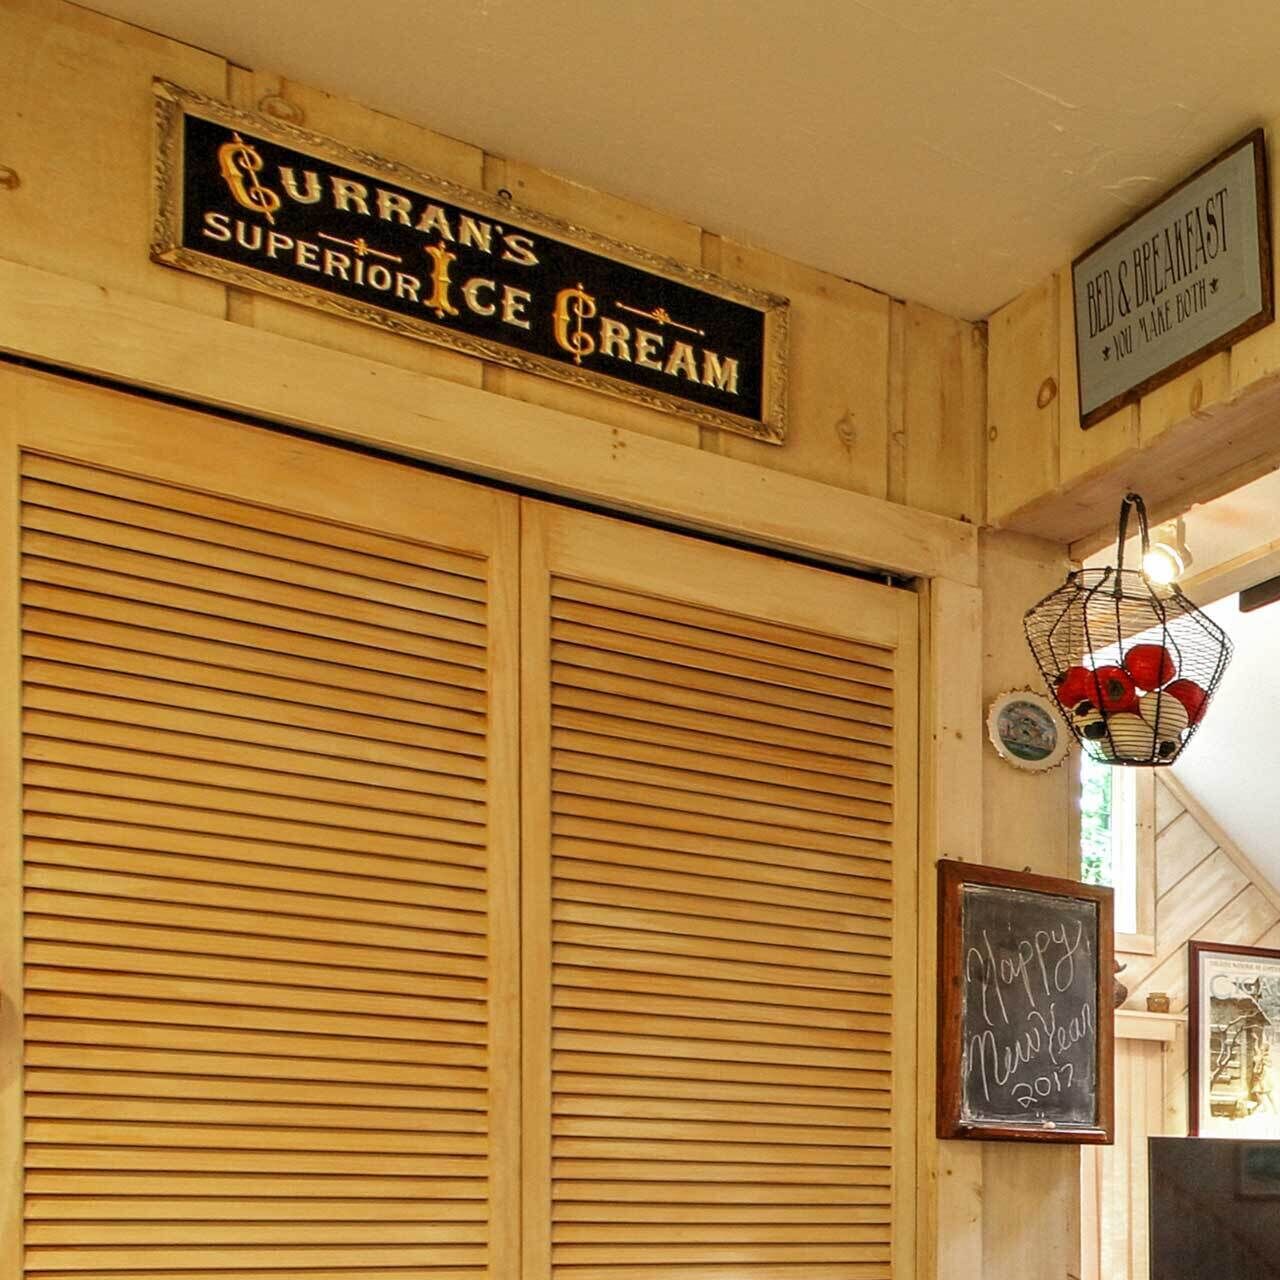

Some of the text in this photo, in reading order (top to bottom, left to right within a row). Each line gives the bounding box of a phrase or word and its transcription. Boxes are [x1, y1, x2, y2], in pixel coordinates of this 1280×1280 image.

[218, 131, 539, 267] CURRAN'S
[203, 211, 739, 395] SUPERIOR ICE CREAM
[1086, 188, 1228, 339] BED & BREAKFAST
[1113, 279, 1209, 361] YOU MAKE BOTH
[967, 920, 1083, 1026] Happy
[969, 1002, 1095, 1102] New Year
[1012, 1063, 1075, 1108] 2017
